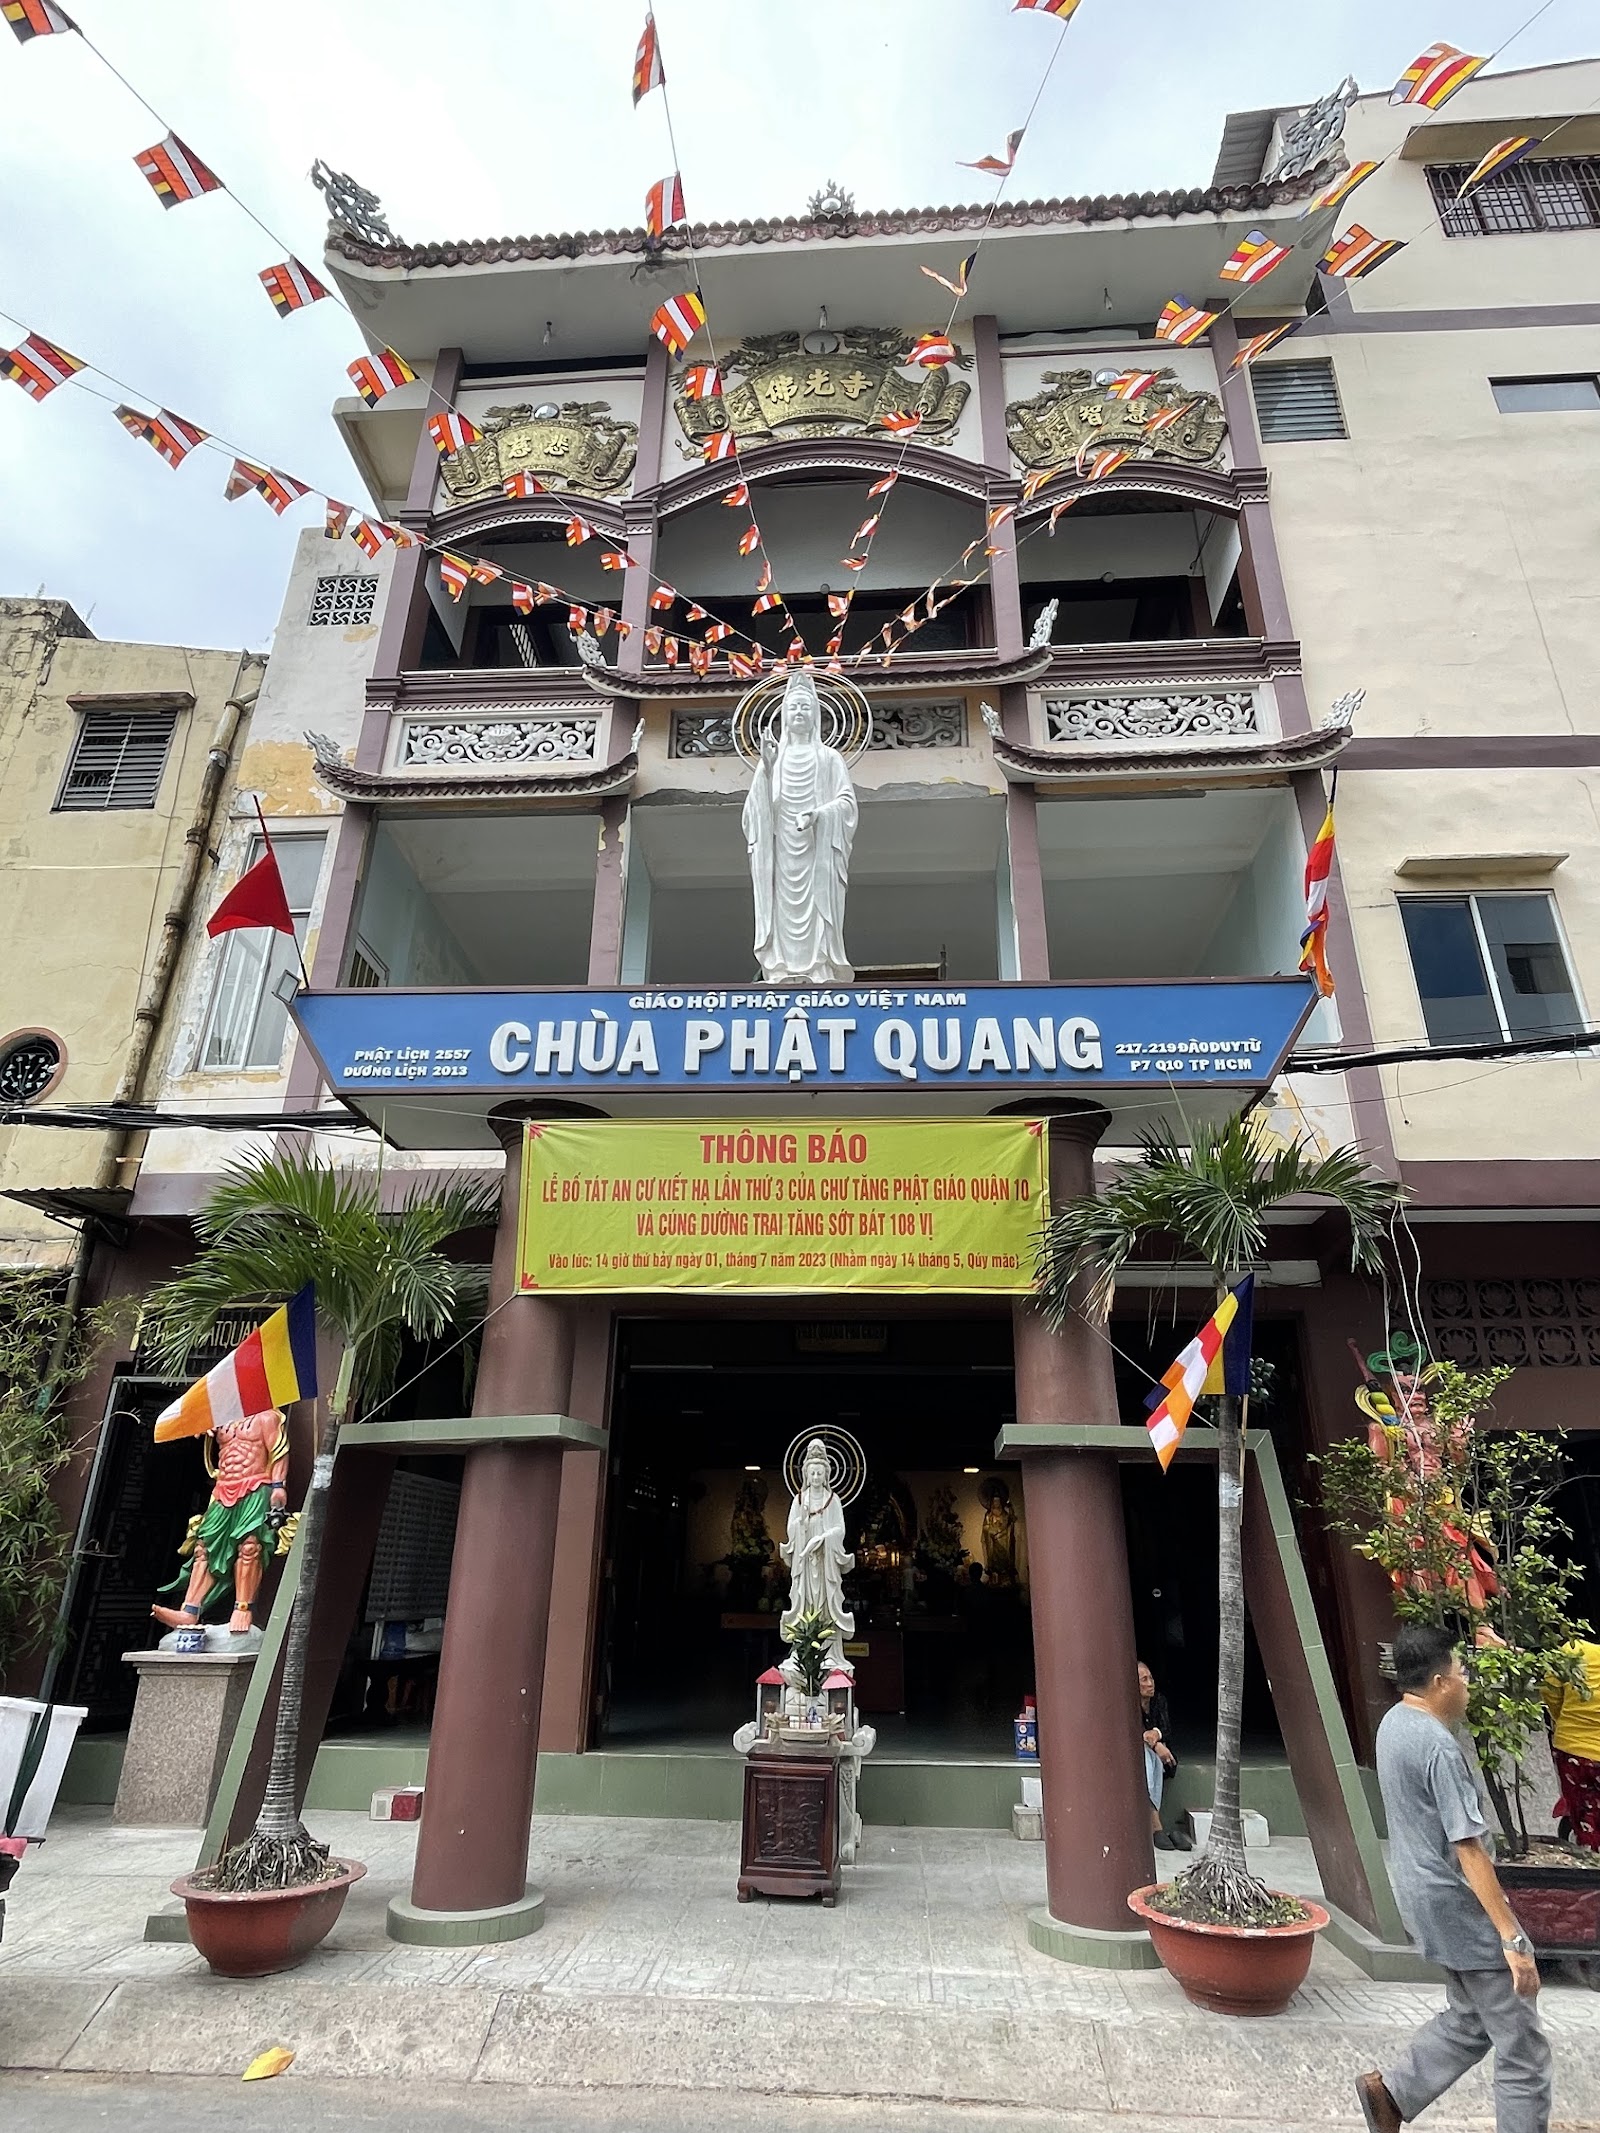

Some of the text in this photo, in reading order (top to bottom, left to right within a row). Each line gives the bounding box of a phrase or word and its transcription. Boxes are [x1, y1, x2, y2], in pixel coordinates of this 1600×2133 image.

[731, 991, 790, 1012] PHẬT
[914, 993, 966, 1006] NAM
[354, 1046, 394, 1064] PHẬT
[435, 1049, 472, 1060] 2557
[489, 1007, 1103, 1083] CHÙA PHẬT QUANG
[432, 1066, 468, 1077] 2013
[1130, 1058, 1252, 1072] P7 Q10 TP HCM
[700, 1128, 867, 1163] THÔNG BÁO
[543, 1171, 1030, 1206] LỄ BỐ TÁT AN CƯ KIẾT HẠ LẦN THỨ 3 CỦA CHƯ TĂNG PHẬT GIÁO QUẬN 10
[637, 1207, 933, 1241] VÀ CÚNG DƯỜNG TRAI TĂNG SỚT BÁT 108 VỊ
[549, 1252, 568, 1268] Vào
[572, 1252, 592, 1268] lúc:
[595, 1253, 608, 1267] 14
[612, 1252, 630, 1269] giờ
[632, 1252, 651, 1268] thứ
[653, 1250, 672, 1269] bảy
[675, 1251, 702, 1268] ngày
[705, 1252, 722, 1268] 01,
[726, 1252, 757, 1268] tháng
[760, 1252, 767, 1267] 7
[771, 1252, 795, 1267] năm
[798, 1252, 826, 1267] 2023
[870, 1252, 897, 1268] ngày
[901, 1252, 915, 1267] 14
[918, 1252, 950, 1269] tháng
[953, 1253, 964, 1269] 5,
